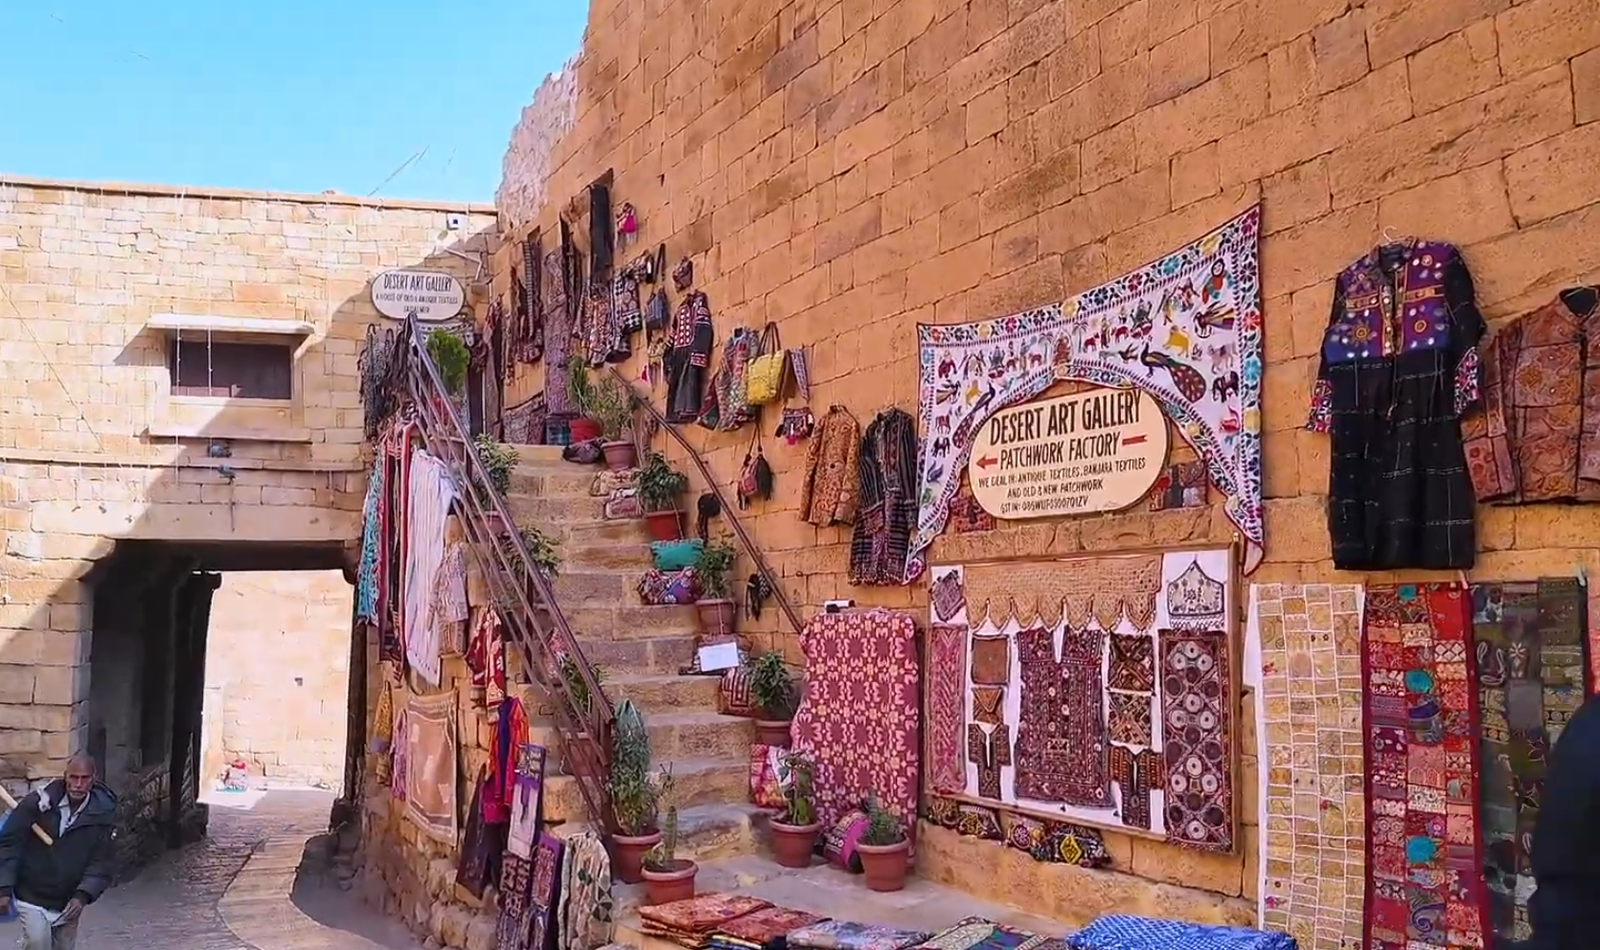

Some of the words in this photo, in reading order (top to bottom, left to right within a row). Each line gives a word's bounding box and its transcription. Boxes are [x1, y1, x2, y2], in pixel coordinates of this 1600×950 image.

[384, 274, 408, 289] DESERT
[410, 276, 424, 291] ART
[426, 276, 452, 292] GALLERY
[396, 293, 403, 302] OF
[990, 407, 1044, 446] DESERT
[1047, 400, 1079, 437] ART
[1083, 390, 1141, 430] GALLERY
[1000, 441, 1064, 470] PATCHWORK
[1069, 431, 1121, 462] FACTORY
[978, 478, 989, 488] WE
[991, 475, 1007, 487] DEAL
[1018, 470, 1046, 482] ANTIQUE
[1115, 457, 1146, 473] TEXTILES
[1007, 487, 1022, 499] AND
[1023, 485, 1037, 498] OLD
[1043, 484, 1058, 495] NEW
[1060, 478, 1104, 494] PATCHWORK
